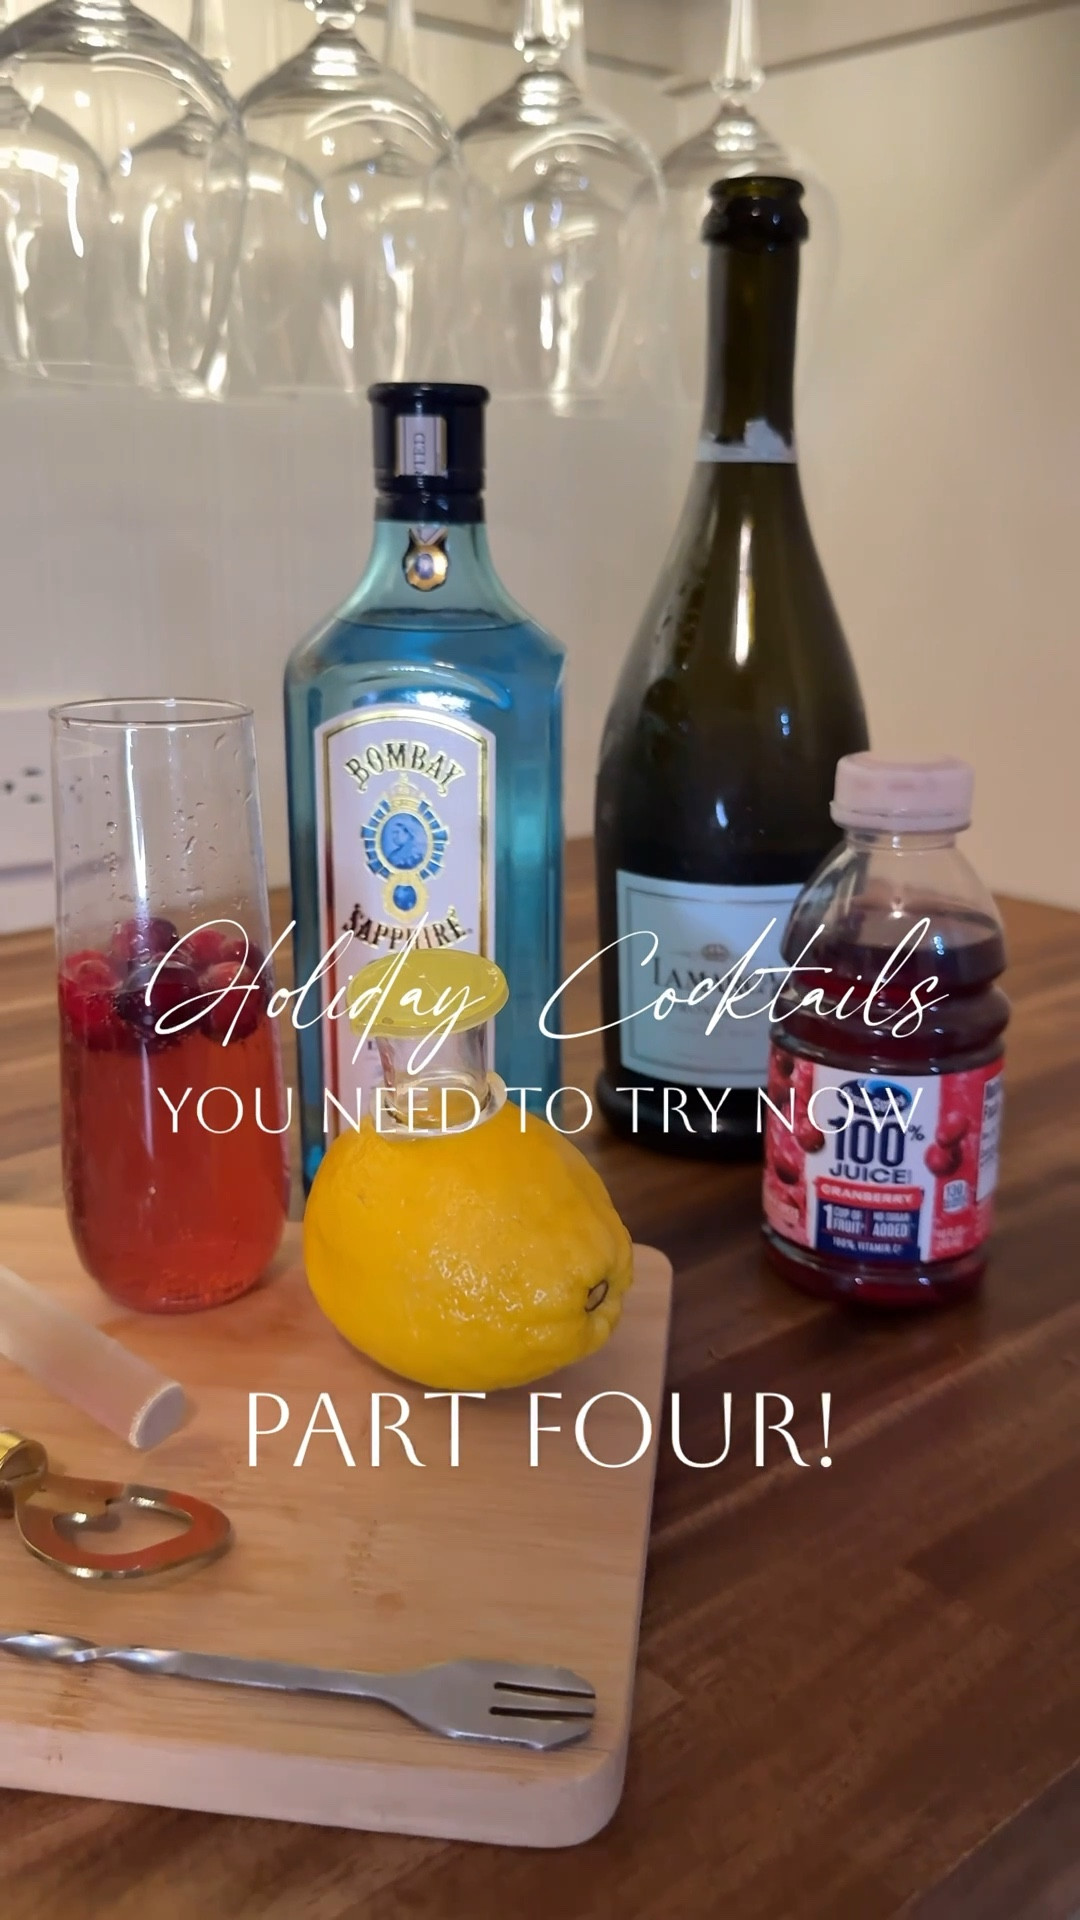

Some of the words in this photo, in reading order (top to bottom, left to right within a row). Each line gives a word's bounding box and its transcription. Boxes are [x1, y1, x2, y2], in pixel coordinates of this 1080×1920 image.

[344, 741, 465, 797] BOMBAY
[829, 1161, 908, 1184] JUICE
[821, 1183, 914, 1204] CRANBERRY
[823, 1203, 833, 1231] 1
[872, 1222, 909, 1238] ADDED
